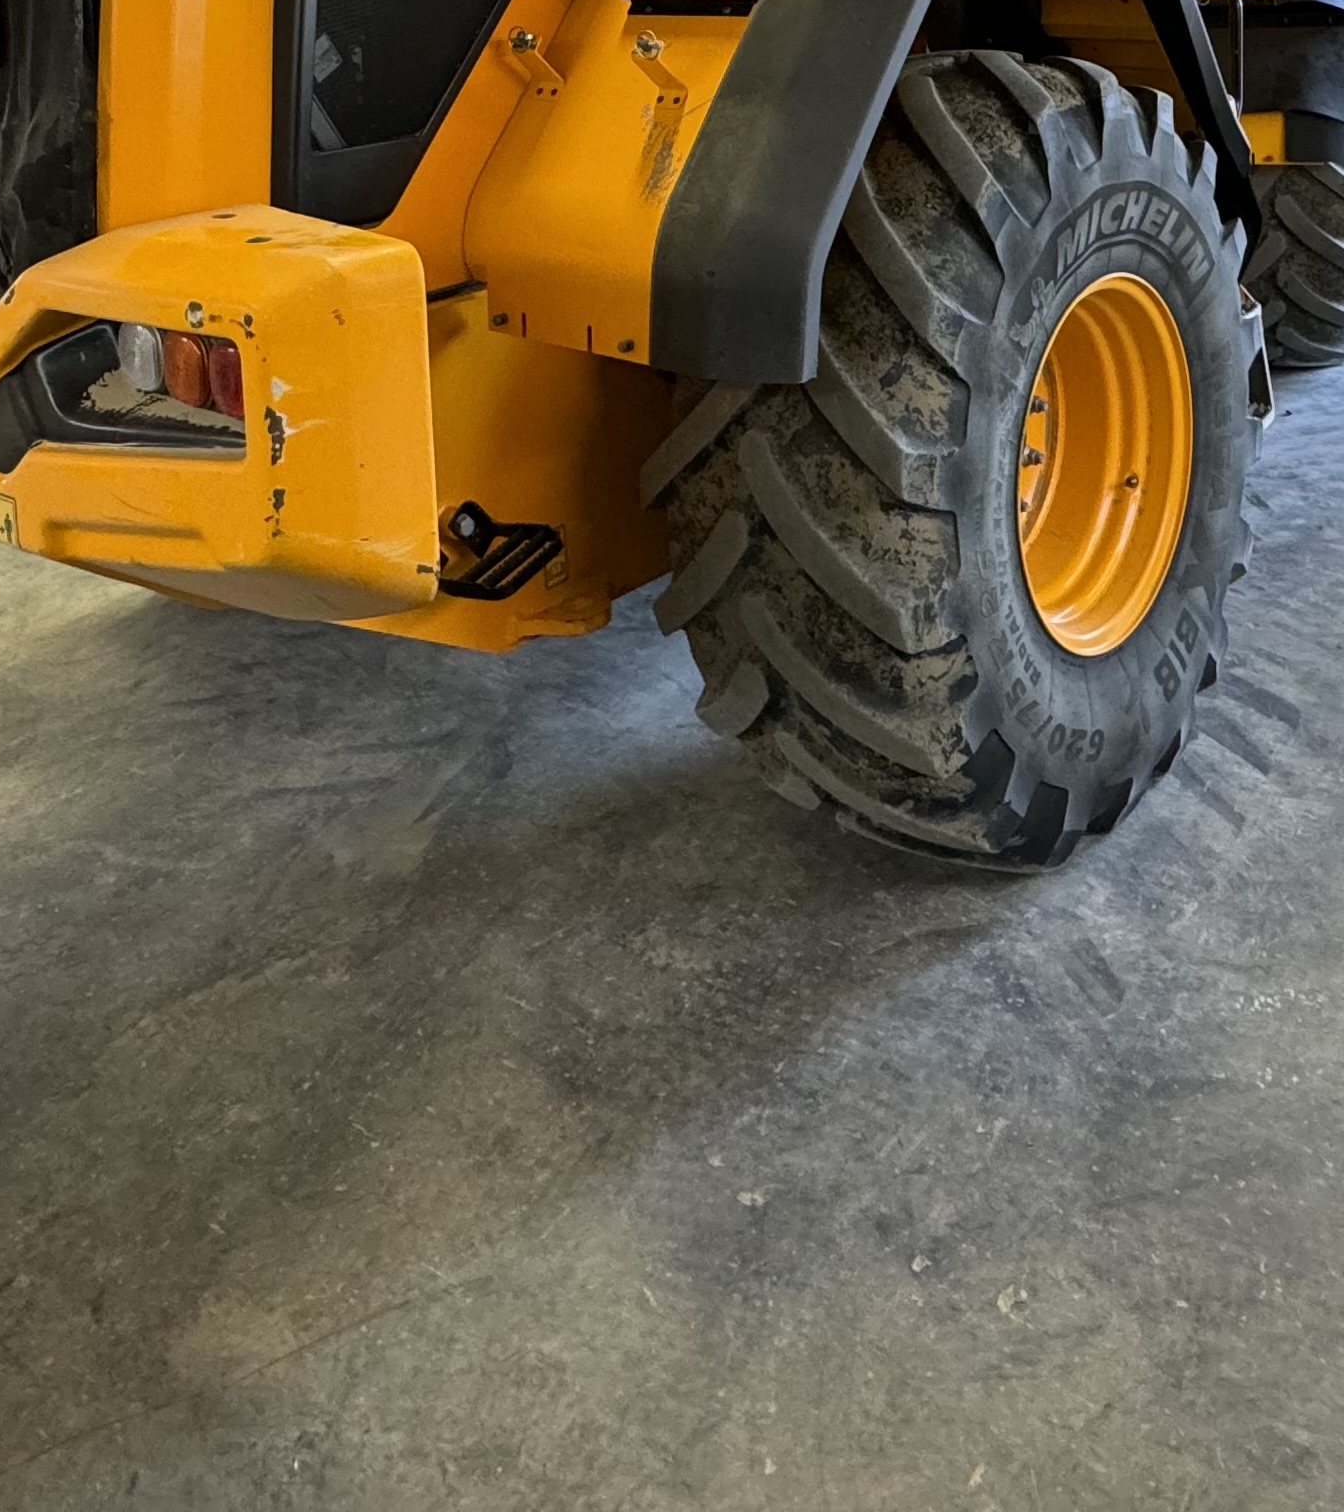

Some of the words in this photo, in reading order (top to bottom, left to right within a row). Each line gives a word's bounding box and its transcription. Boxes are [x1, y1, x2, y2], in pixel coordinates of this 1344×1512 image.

[1056, 190, 1210, 282] MICHELIN
[1005, 604, 1041, 686] RADIAL
[1154, 606, 1200, 703] BIB
